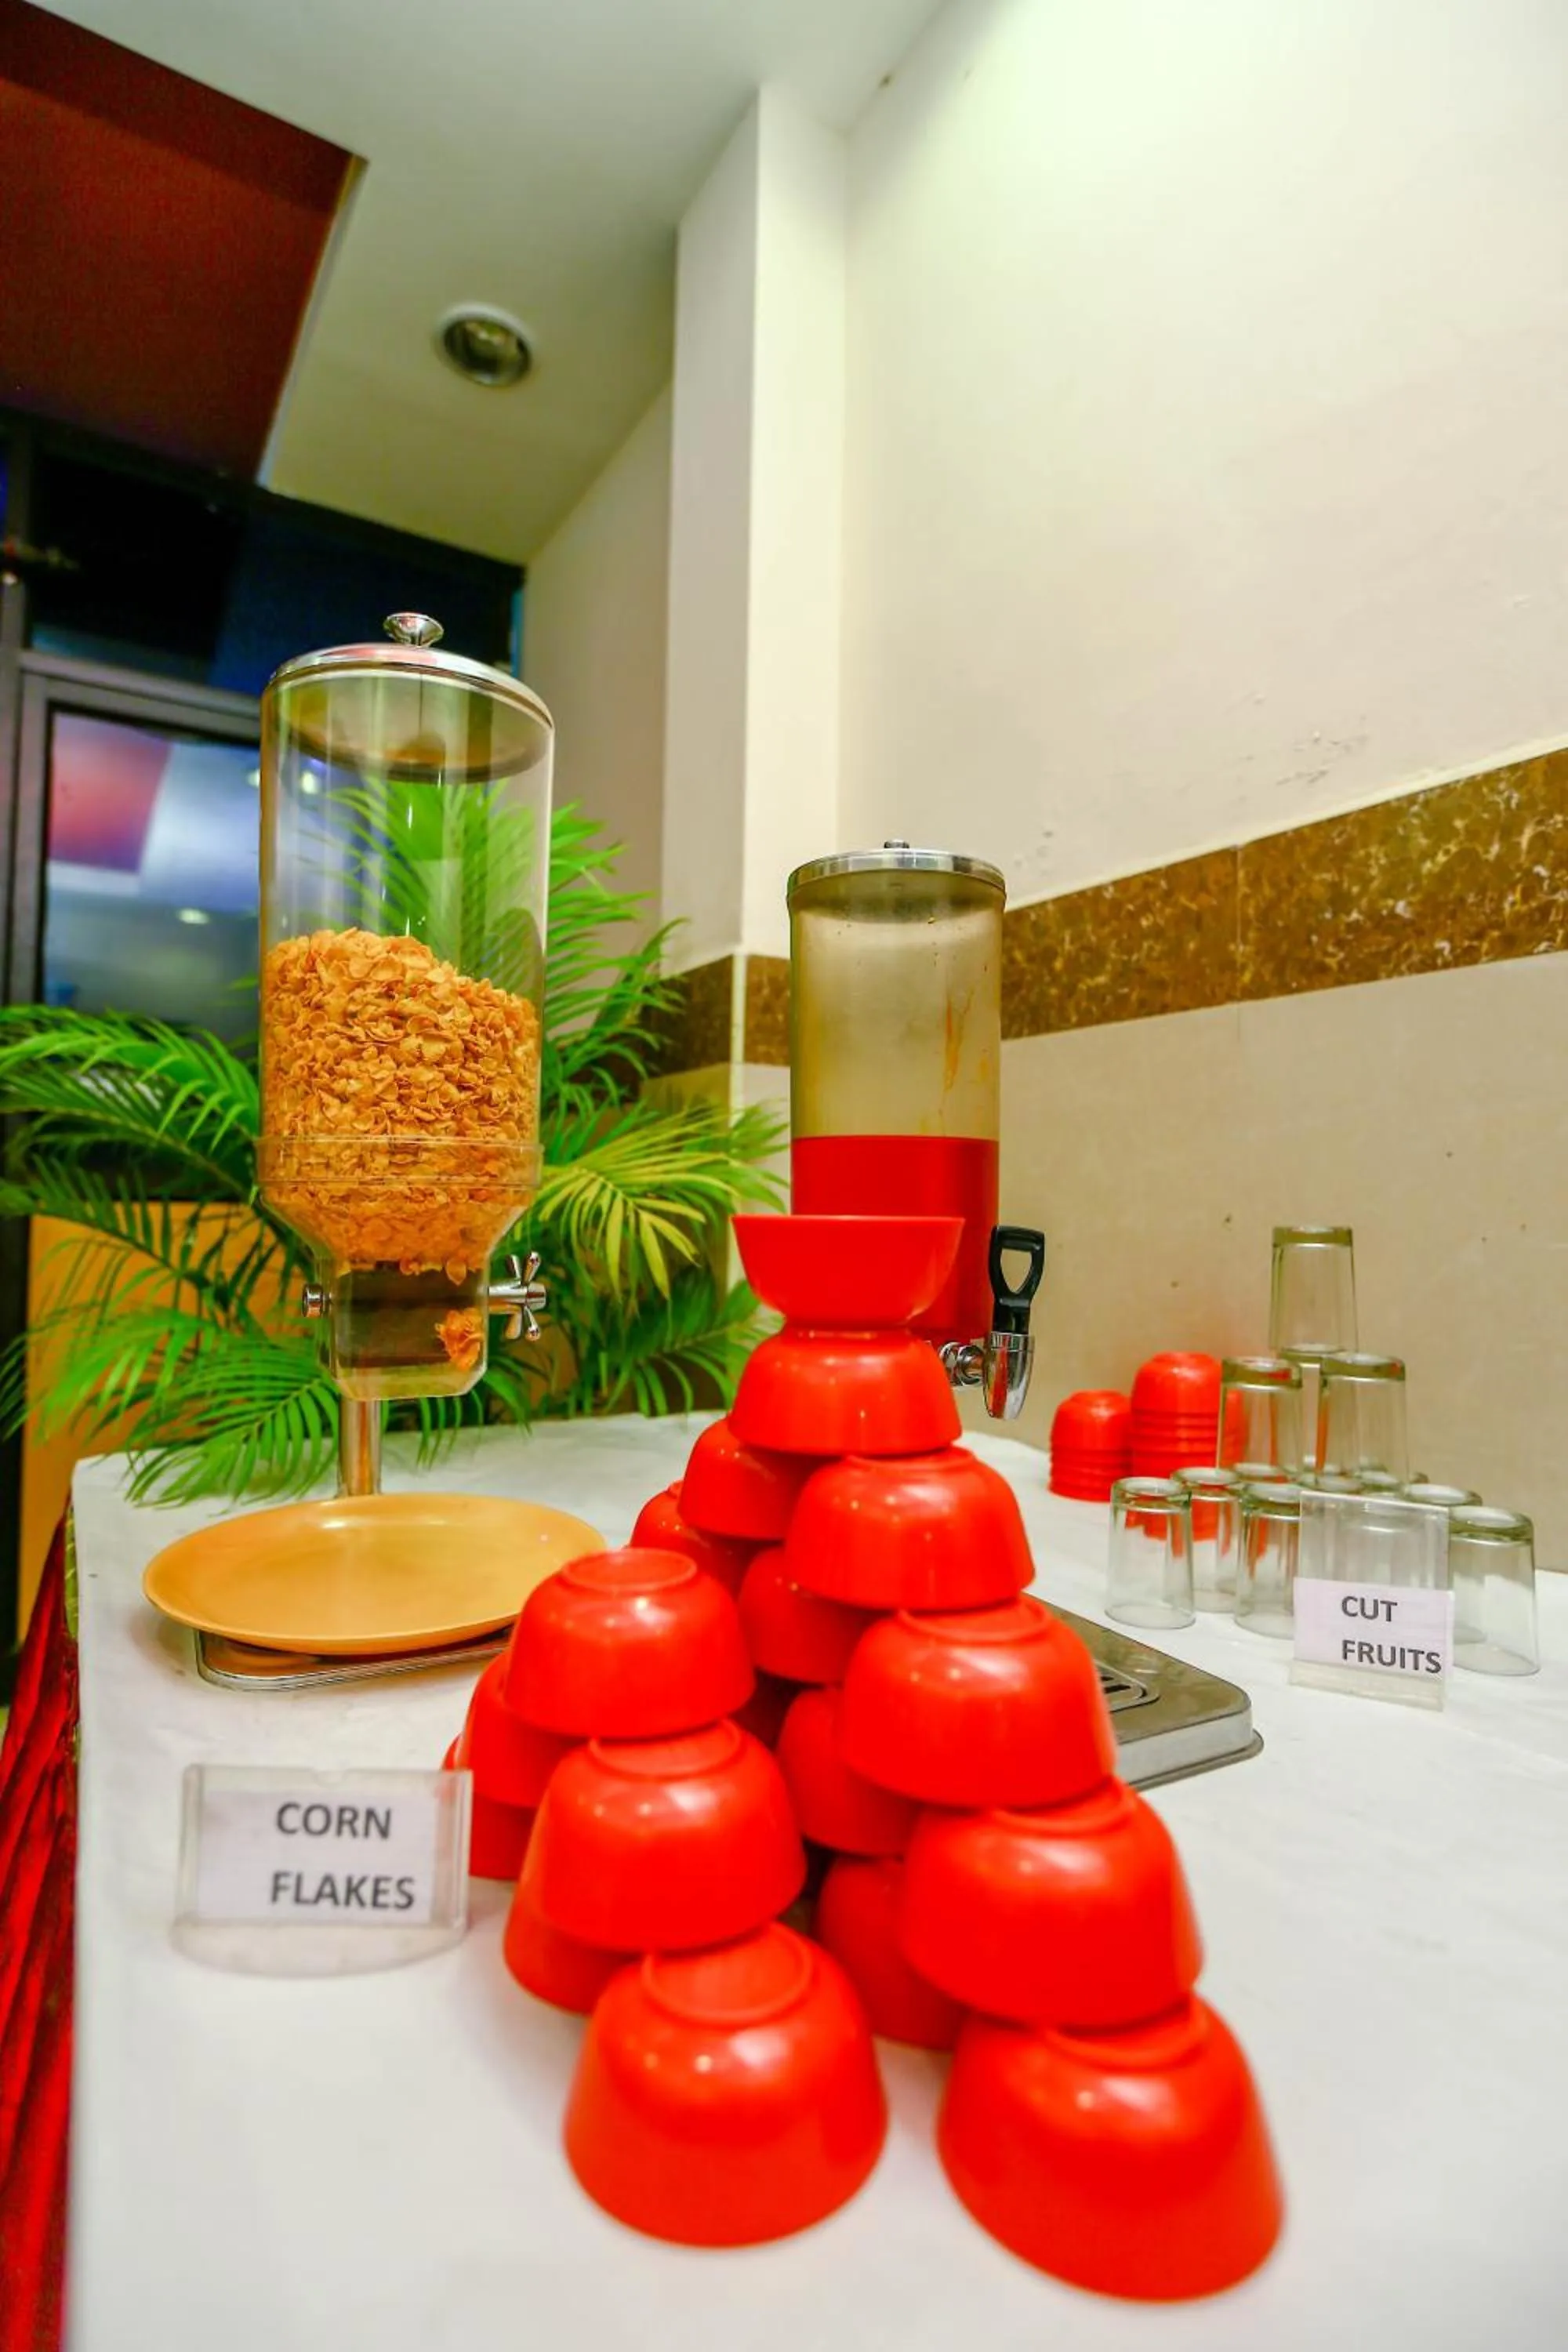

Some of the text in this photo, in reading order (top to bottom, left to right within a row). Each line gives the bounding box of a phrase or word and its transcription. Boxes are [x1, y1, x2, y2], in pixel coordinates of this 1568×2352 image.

[1341, 1595, 1399, 1623] CUT
[1341, 1639, 1443, 1675] FRUITS
[276, 1802, 392, 1839] CORN
[270, 1871, 416, 1911] FLAKES
